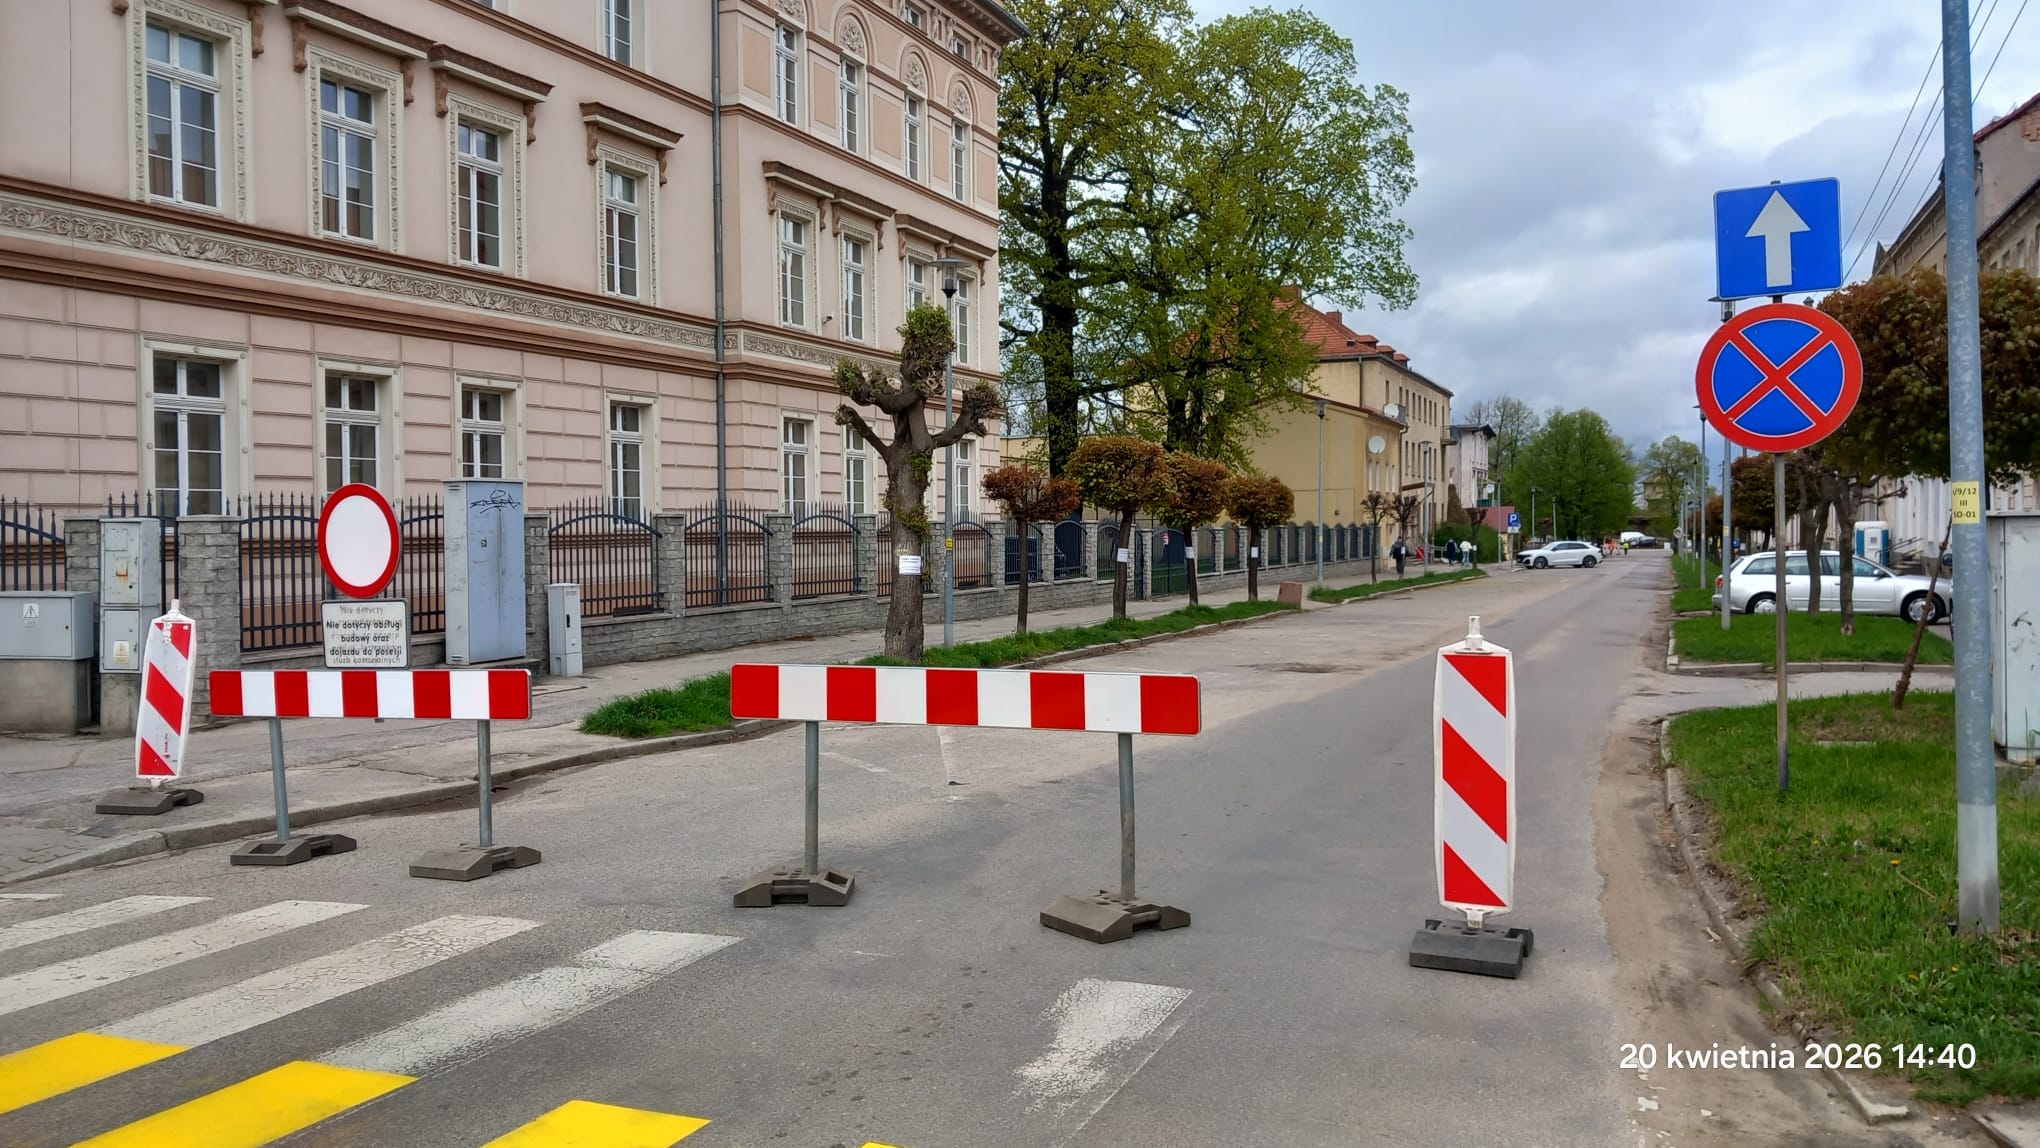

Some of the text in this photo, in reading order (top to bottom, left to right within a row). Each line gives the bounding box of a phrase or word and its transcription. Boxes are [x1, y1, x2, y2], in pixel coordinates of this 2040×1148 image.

[1510, 514, 1517, 524] P
[326, 620, 339, 629] Nie
[342, 620, 371, 631] dotyczy
[341, 633, 370, 644] budowy
[373, 634, 389, 642] oraz
[329, 647, 402, 657] dojazdu do posesji
